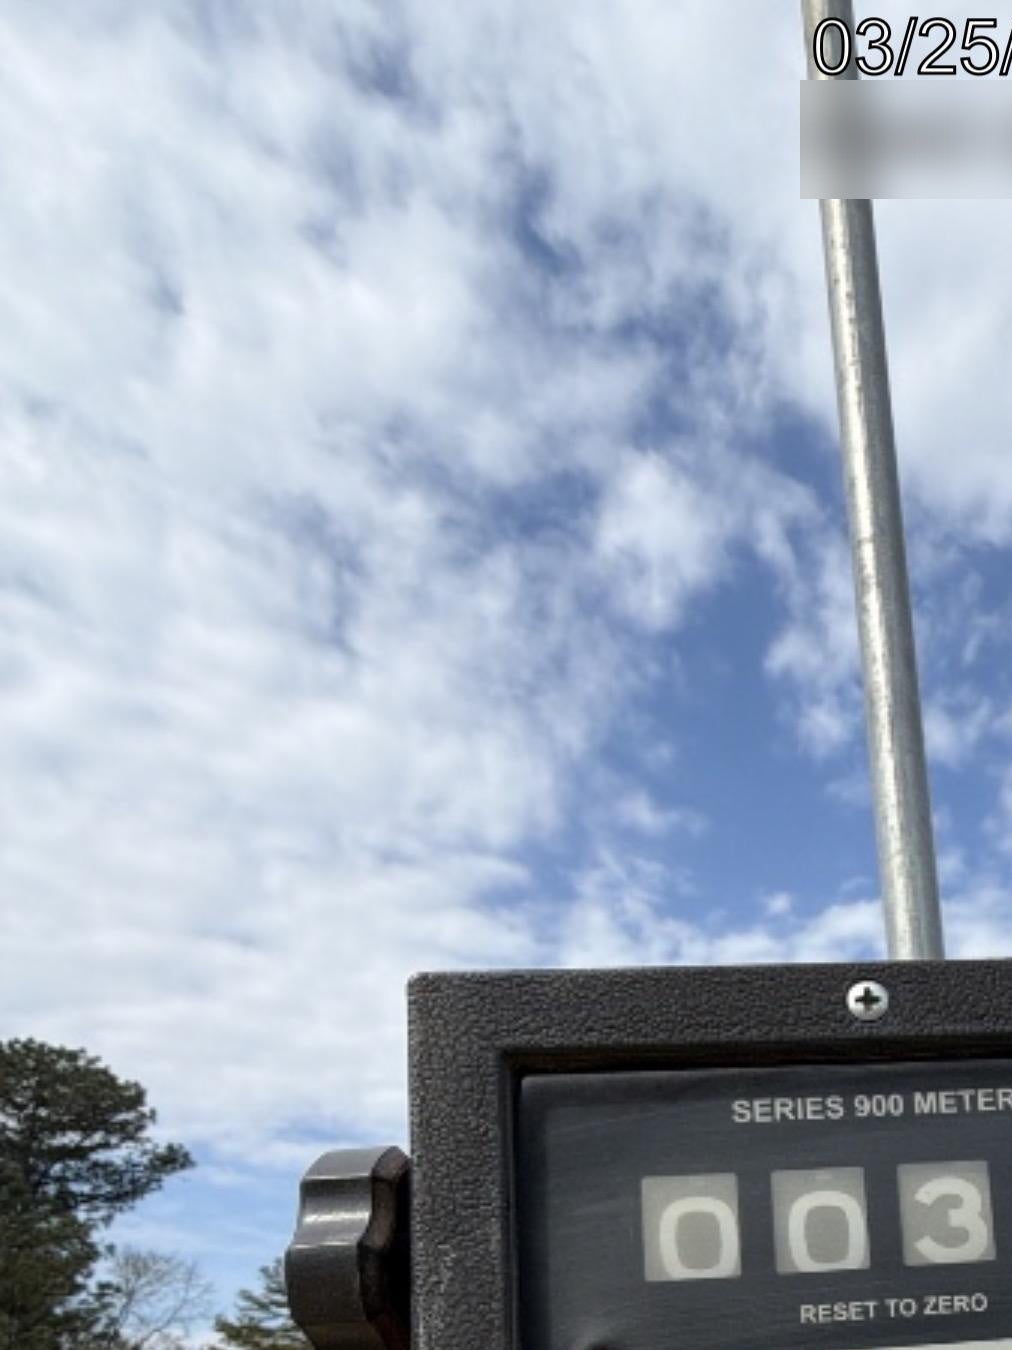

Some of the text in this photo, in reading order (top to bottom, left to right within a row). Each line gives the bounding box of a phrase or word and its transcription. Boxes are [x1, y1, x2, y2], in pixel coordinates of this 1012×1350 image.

[731, 1095, 844, 1123] SERIES
[853, 1094, 904, 1117] 900
[799, 1292, 988, 1324] RESET TO ZERO
